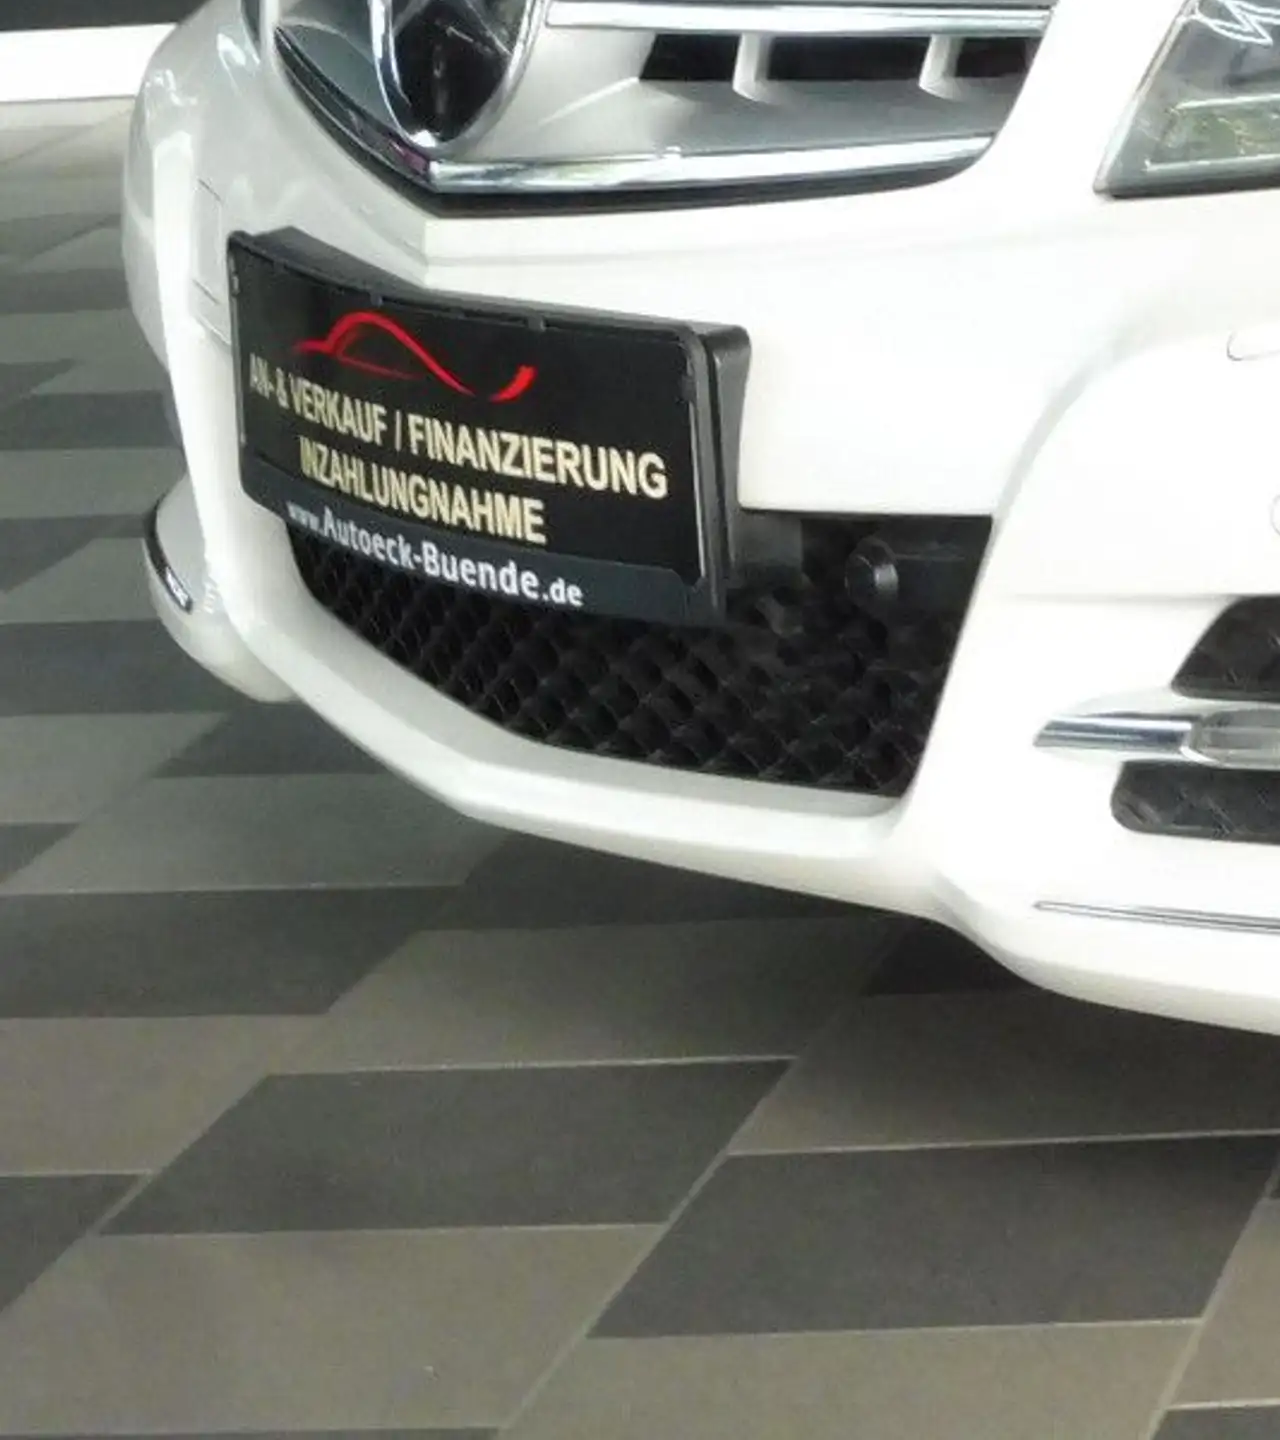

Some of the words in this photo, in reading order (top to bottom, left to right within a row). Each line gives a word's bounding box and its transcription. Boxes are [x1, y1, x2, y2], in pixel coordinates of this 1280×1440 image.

[275, 367, 289, 410] &
[288, 372, 388, 448] VERKAUF
[394, 408, 402, 452] /
[407, 412, 669, 500] FINANZIERUNG
[299, 434, 547, 546] INZAHLUNGNAHME
[285, 501, 586, 608] www.Autoeck-Buende.de
